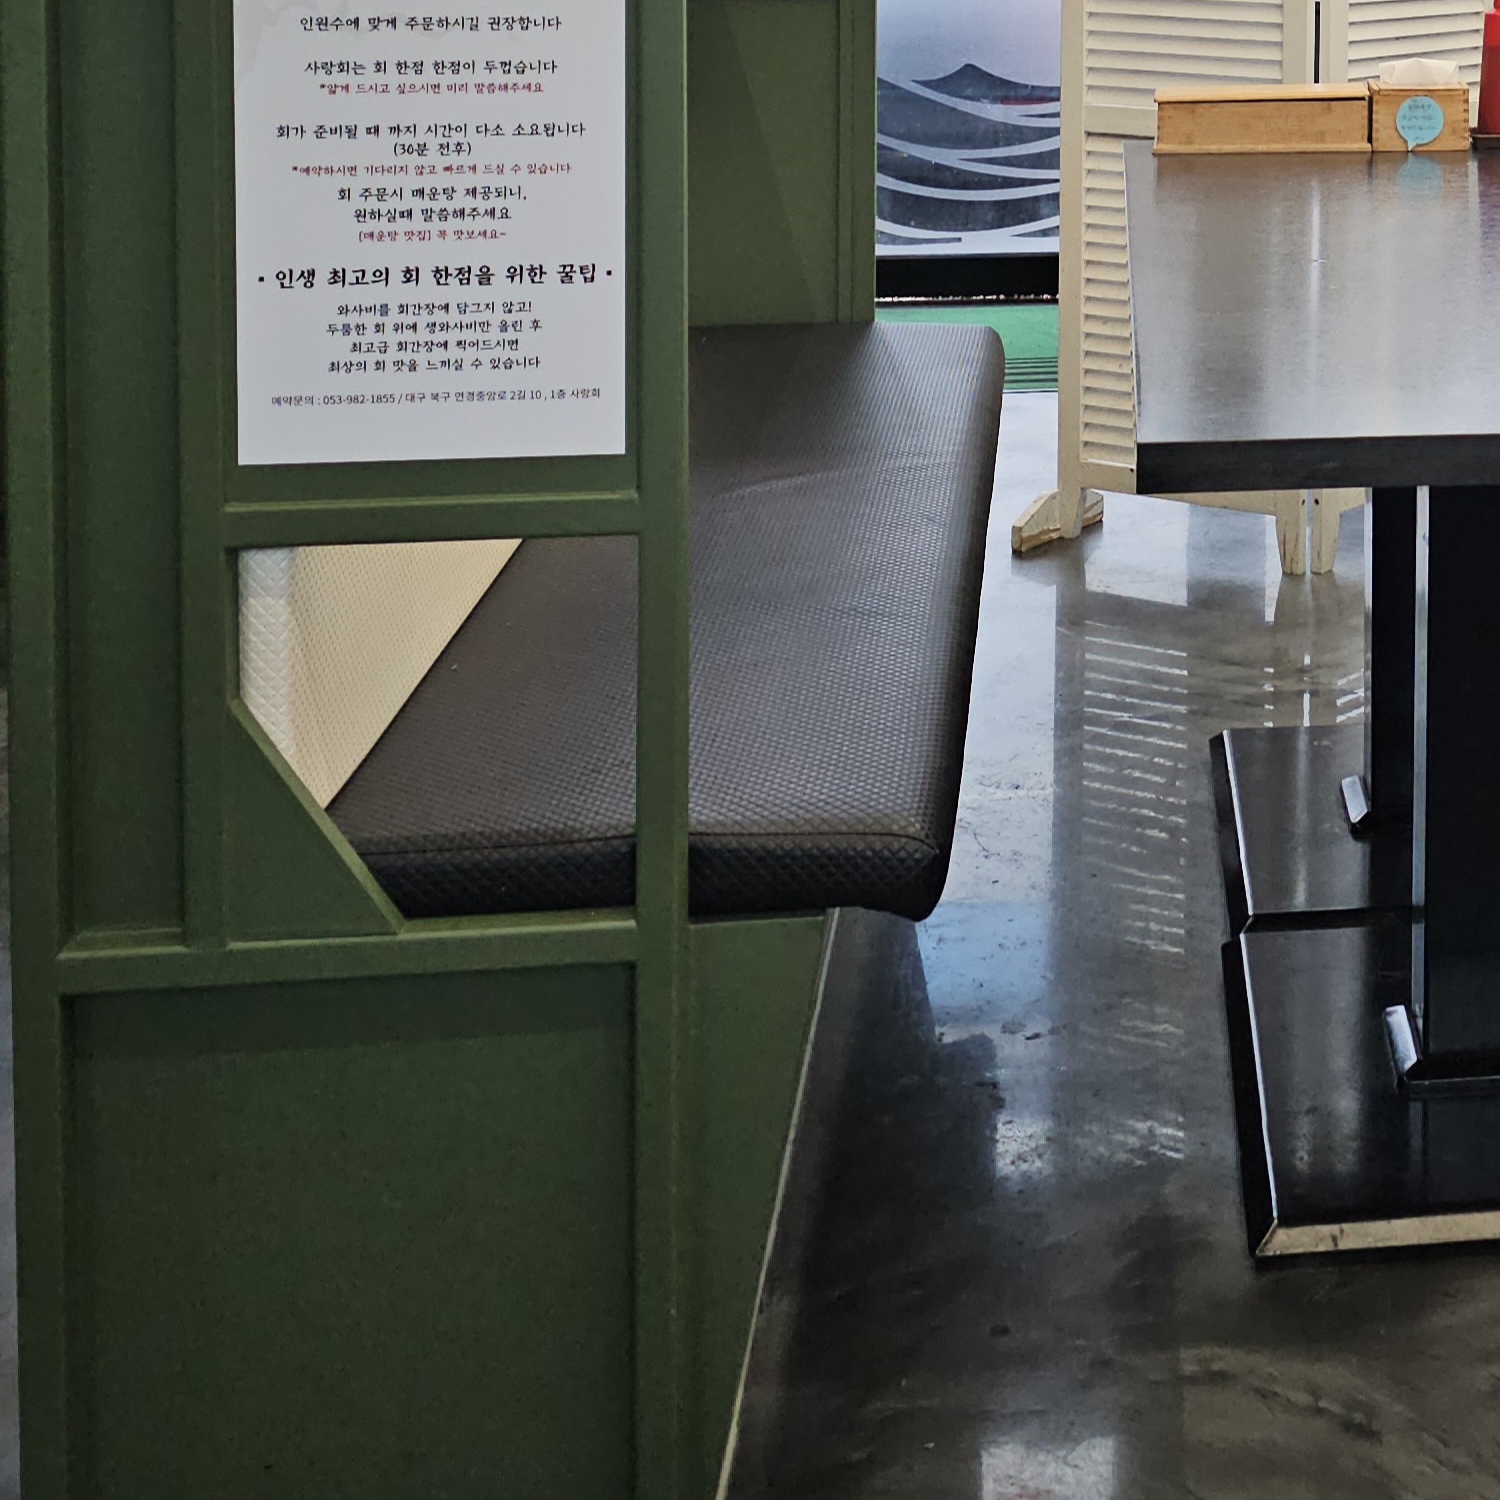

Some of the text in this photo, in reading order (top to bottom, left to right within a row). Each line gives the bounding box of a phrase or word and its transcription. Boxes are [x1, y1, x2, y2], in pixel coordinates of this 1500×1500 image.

[299, 15, 563, 33] 인원수에 맞게 주문하시길 권장합니다
[303, 58, 559, 76] 사랑회는 회 한점 한점이 두껍습니다
[355, 82, 391, 95] 드시고
[446, 81, 469, 95] 미리
[473, 81, 544, 95] 말씀해주세요
[275, 122, 307, 140] 회가
[364, 122, 380, 140] 때
[386, 121, 417, 139] 까지
[423, 121, 468, 139] 시간이
[475, 121, 506, 138] 다소
[511, 120, 587, 138] 소요됩니다
[435, 140, 472, 157] 전후)
[363, 162, 409, 177] 기다리지
[482, 161, 505, 176] 드실
[509, 162, 522, 174] 수
[526, 161, 573, 175] 있습니다
[337, 184, 527, 203] 회 주문시 매운탕 제공되니,
[352, 205, 513, 223] 원하실때 말씀해주세요
[403, 229, 432, 242] 맛집]
[436, 229, 448, 242] 꼭
[452, 227, 507, 240] 맛보세요~
[274, 261, 596, 290] 인생 최고의 회 한점을 위한 꿀팁
[336, 299, 532, 318] 와사비를 회간장에 담그지 않고!
[373, 320, 386, 335] 회
[391, 320, 418, 336] 위에
[423, 318, 493, 335] 생와사비만
[528, 317, 543, 332] 후
[349, 339, 391, 355] 최고급
[395, 337, 449, 354] 회간장에
[327, 354, 542, 375] 최상의 회 맛을 느끼실 수 있습니다
[322, 392, 396, 405] 053-982-1855
[404, 391, 427, 404] 대구
[430, 390, 451, 403] 북구
[509, 388, 526, 401] 2길
[529, 388, 542, 400] 10
[550, 388, 567, 400] 1층
